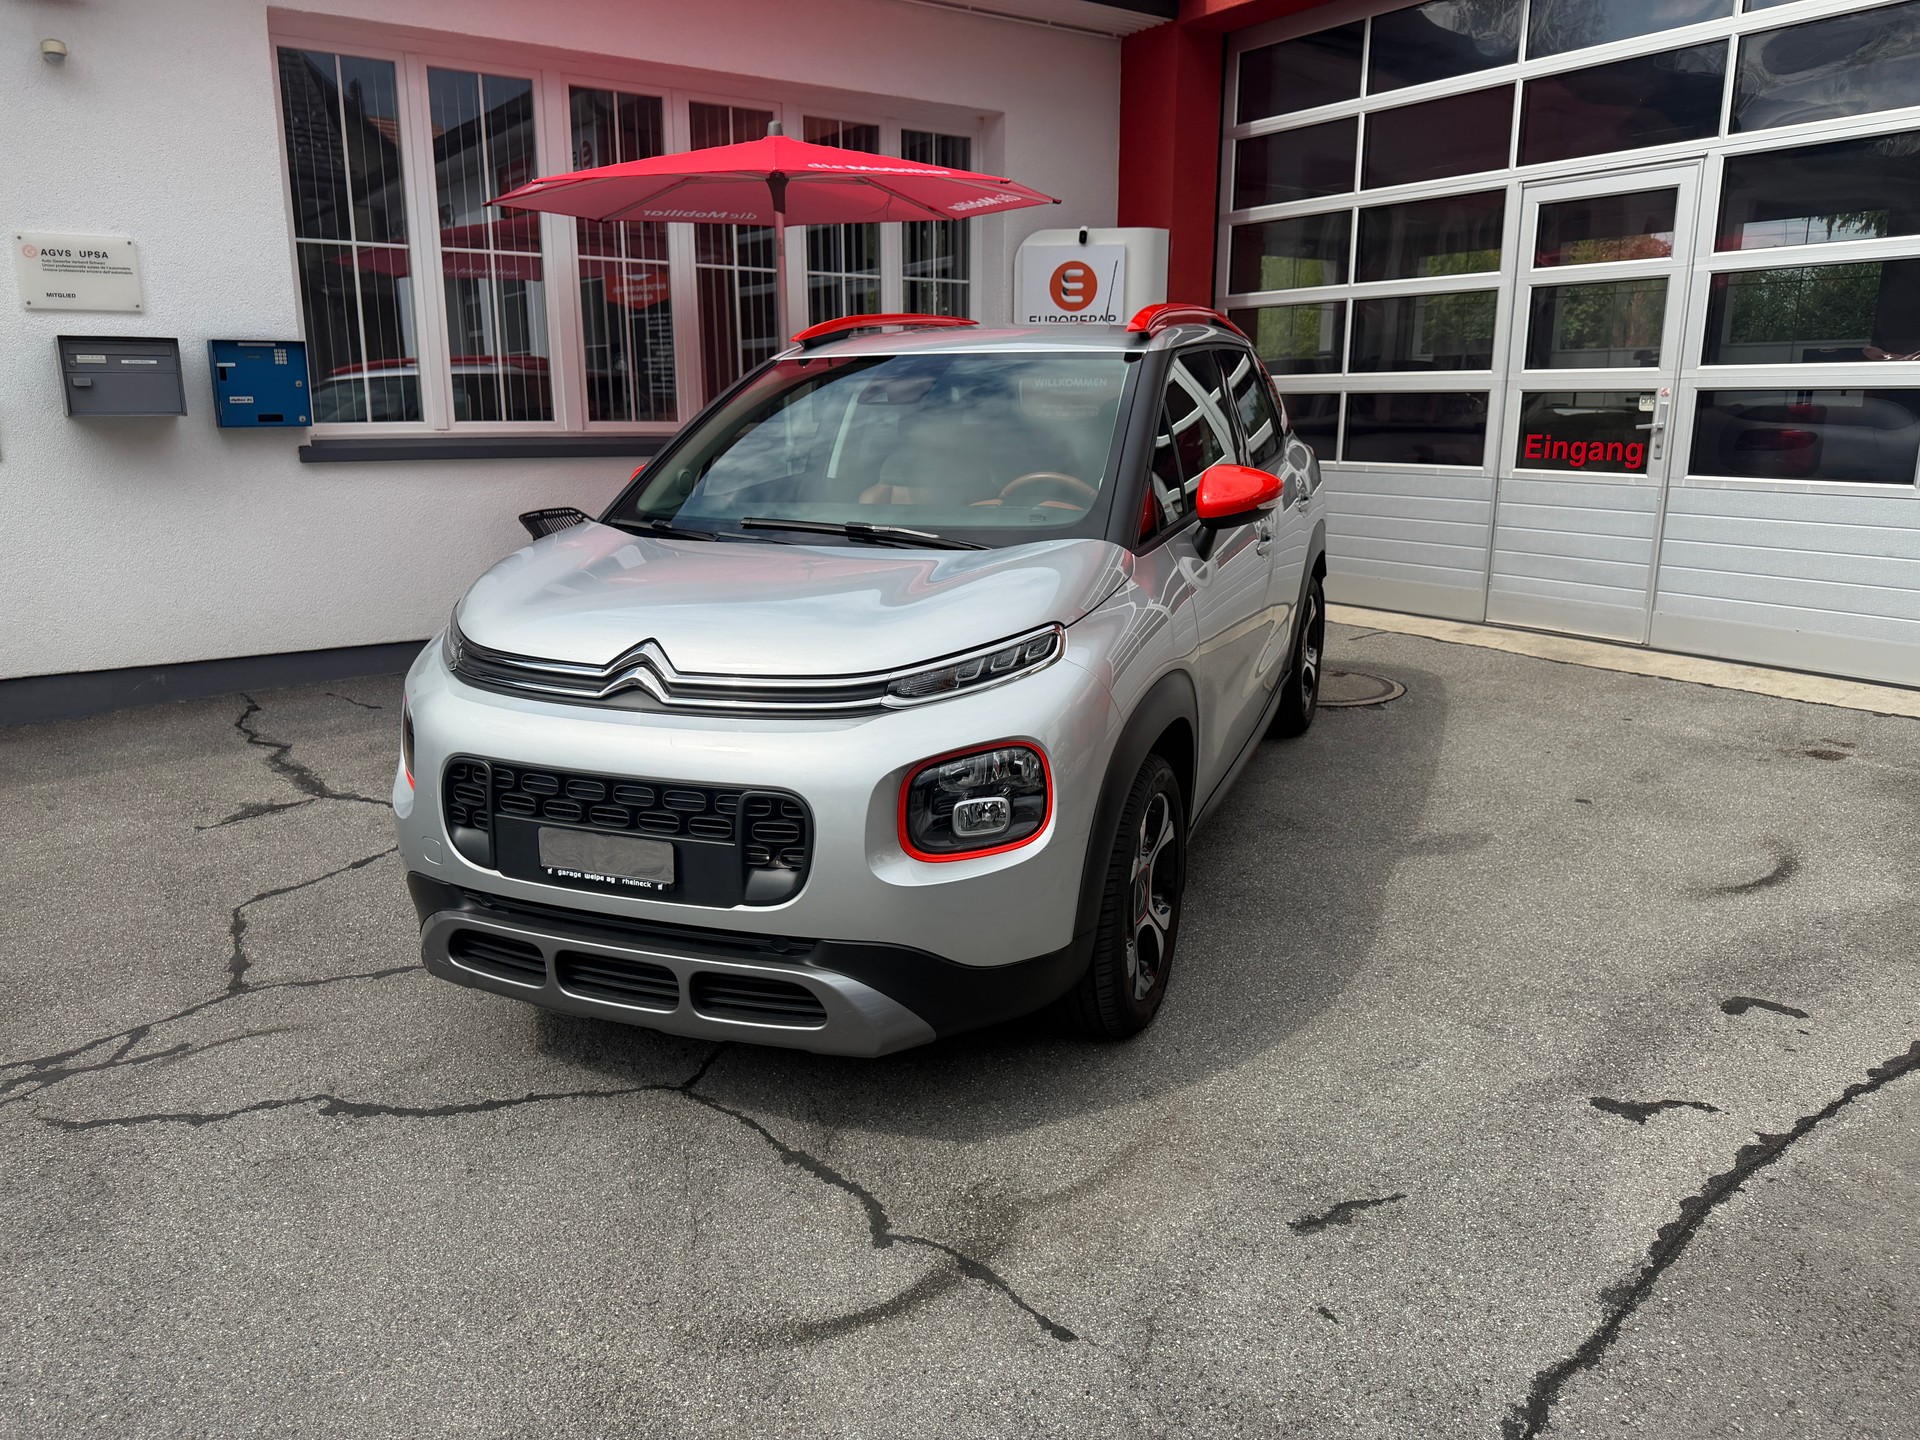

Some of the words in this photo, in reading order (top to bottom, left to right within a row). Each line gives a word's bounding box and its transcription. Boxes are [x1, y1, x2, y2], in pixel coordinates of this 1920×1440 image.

[40, 248, 72, 258] AGVS
[79, 250, 109, 259] UPSA
[1034, 378, 1107, 387] WILLKOMMEN
[1525, 434, 1644, 469] Eingang
[557, 869, 582, 878] garage
[606, 876, 616, 884] ag
[621, 878, 652, 888] rheineck
